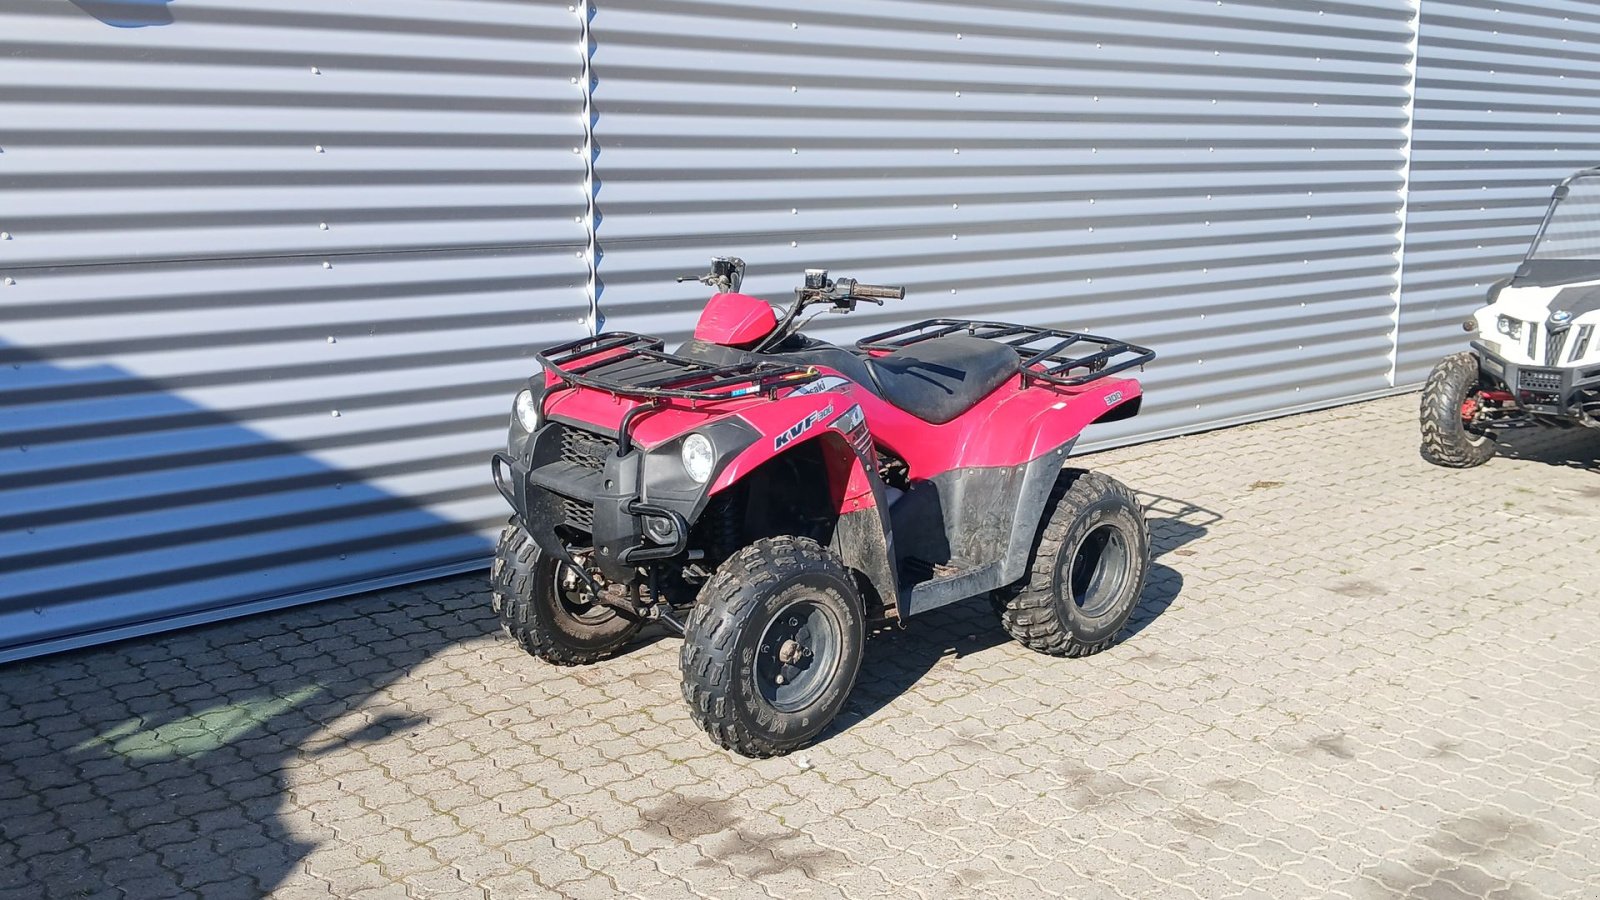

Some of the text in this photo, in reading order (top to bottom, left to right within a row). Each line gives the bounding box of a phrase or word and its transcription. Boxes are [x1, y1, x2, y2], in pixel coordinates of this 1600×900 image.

[805, 380, 826, 394] saki
[1104, 391, 1122, 405] 300
[775, 404, 834, 450] KVF 300
[741, 647, 787, 734] MAXXIS
